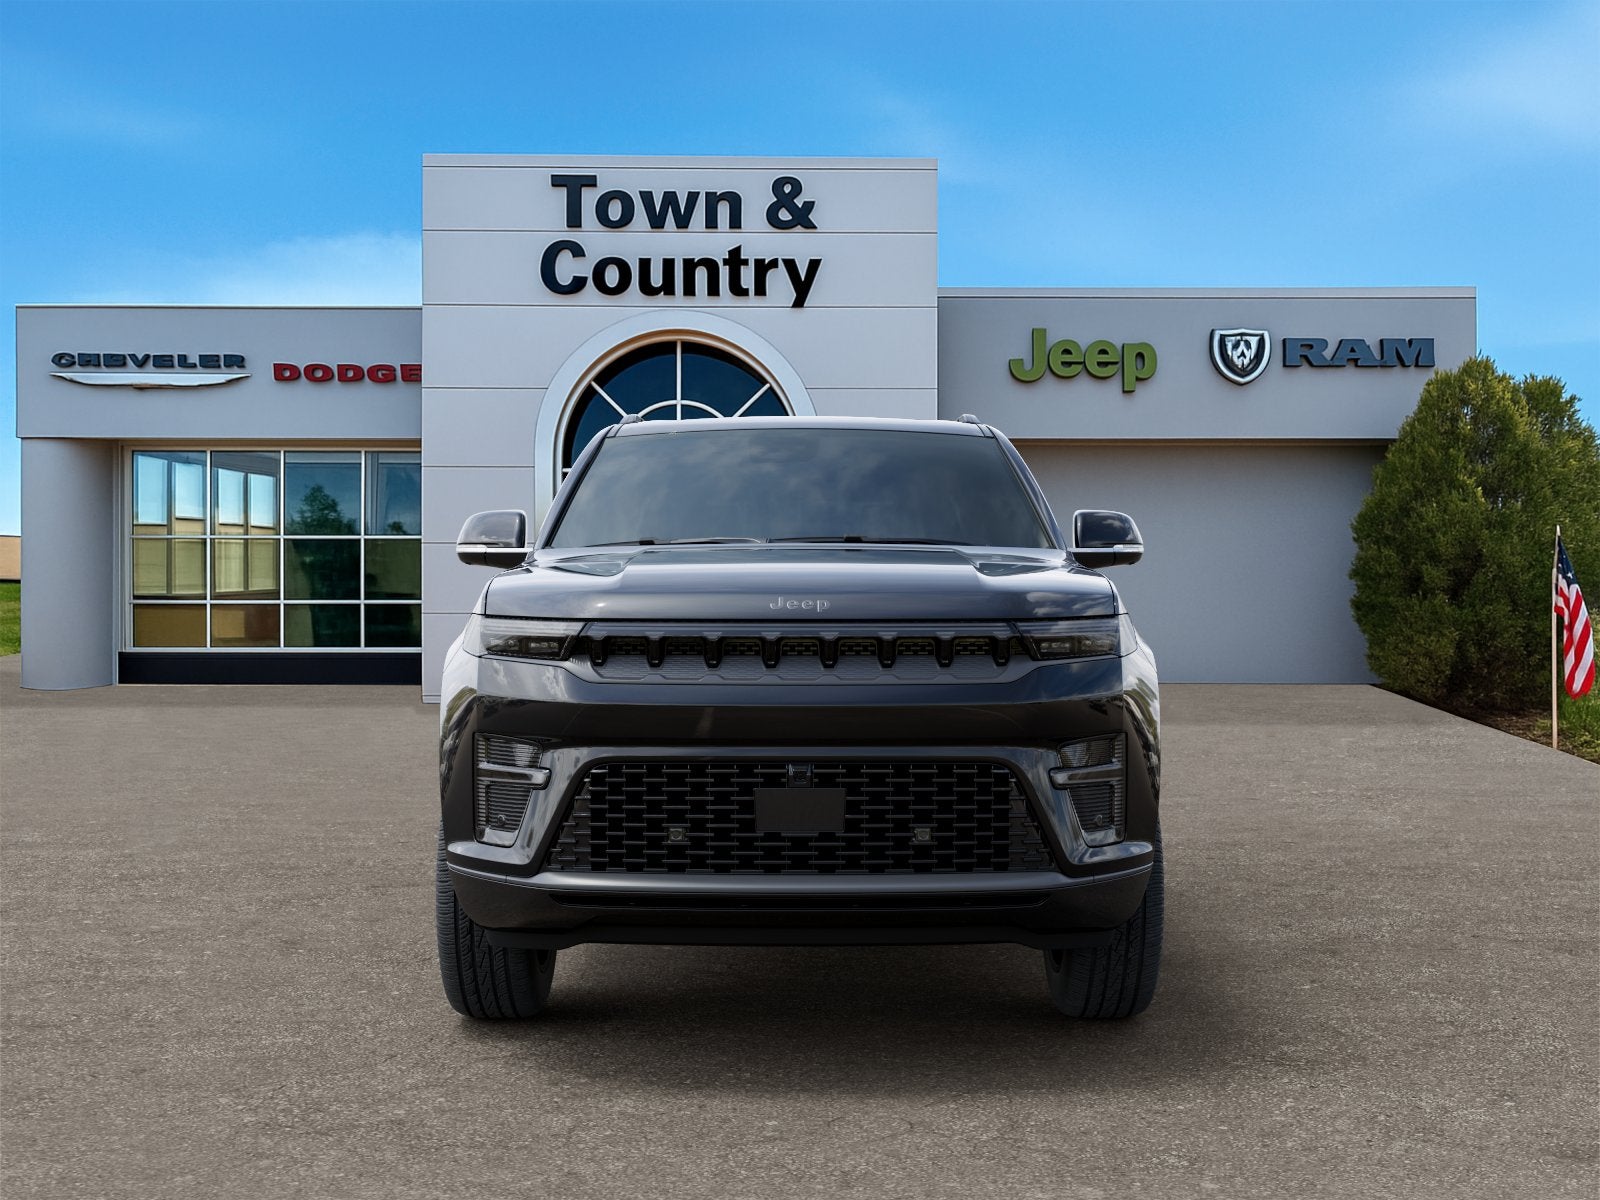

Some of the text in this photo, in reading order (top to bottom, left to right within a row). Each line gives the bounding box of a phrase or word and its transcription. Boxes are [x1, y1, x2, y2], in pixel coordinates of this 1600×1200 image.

[550, 174, 818, 229] Town &
[540, 239, 822, 307] Country
[273, 362, 422, 382] DODGE
[1009, 328, 1157, 392] Jeep
[1283, 338, 1435, 367] RAM
[769, 596, 831, 612] Jeep
